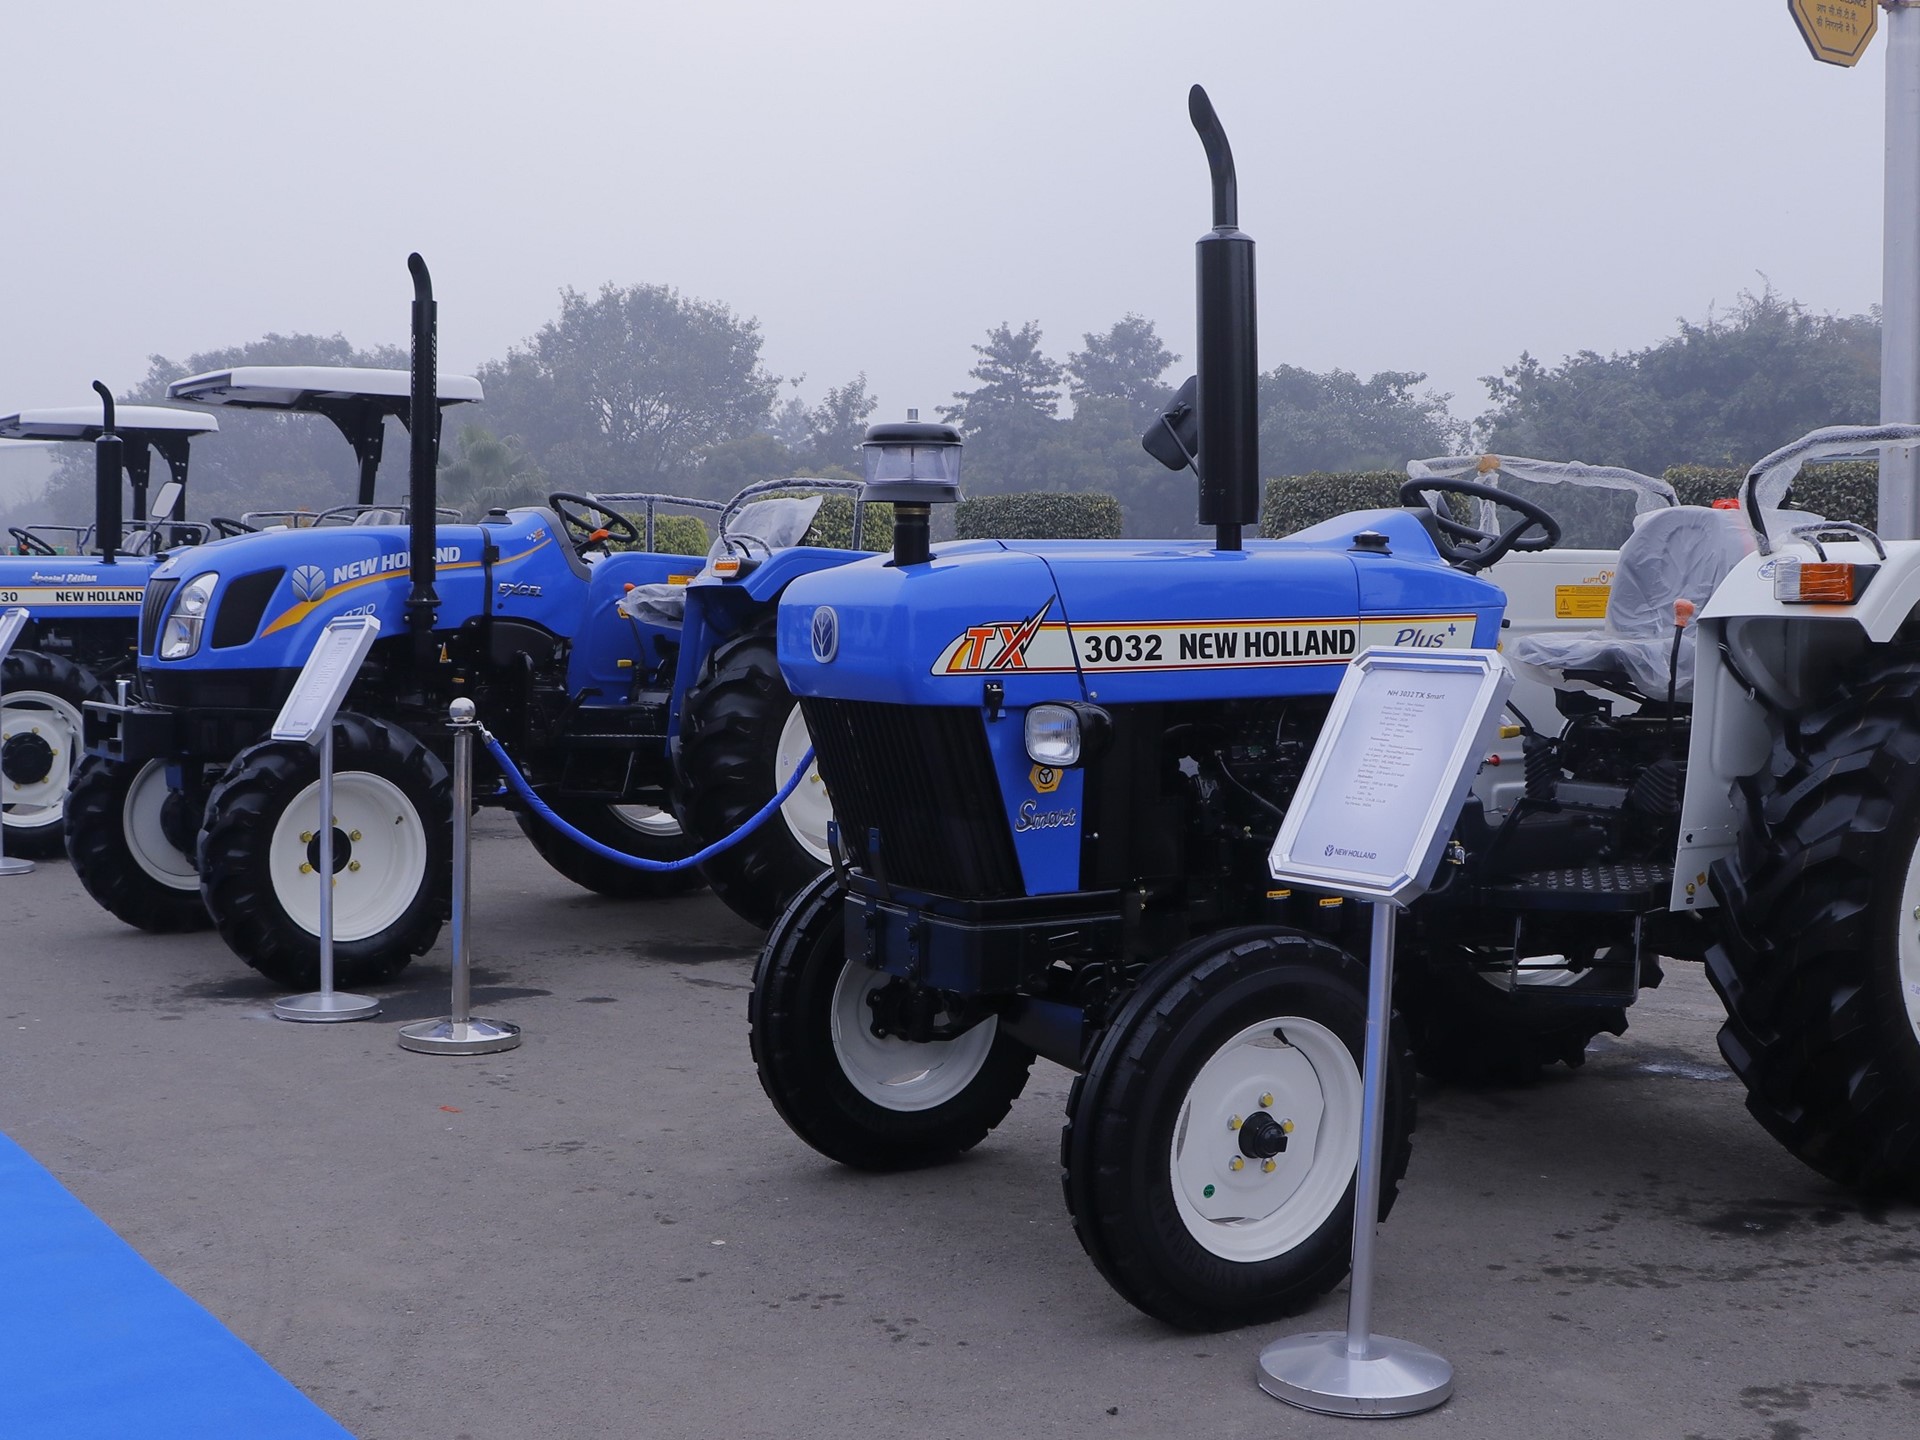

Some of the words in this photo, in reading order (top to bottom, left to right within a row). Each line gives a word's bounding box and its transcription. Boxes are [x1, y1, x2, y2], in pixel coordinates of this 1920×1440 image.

[333, 557, 377, 584] NEW
[381, 546, 461, 572] HOND
[31, 571, 66, 584] Special
[66, 573, 98, 583] Edition
[498, 580, 542, 597] EXCEL
[56, 591, 84, 602] NEW
[88, 591, 144, 602] HOLLAND
[965, 608, 1045, 670] TX
[1084, 634, 1163, 663] 3032
[1179, 632, 1238, 660] NEW
[1244, 629, 1356, 658] HOLLAND
[1399, 690, 1415, 698] 3032
[1415, 691, 1425, 699] TX
[1426, 692, 1445, 700] Smart
[1015, 799, 1076, 833] Smart
[1335, 848, 1348, 857] NEW
[1348, 849, 1377, 860] HOLLAND
